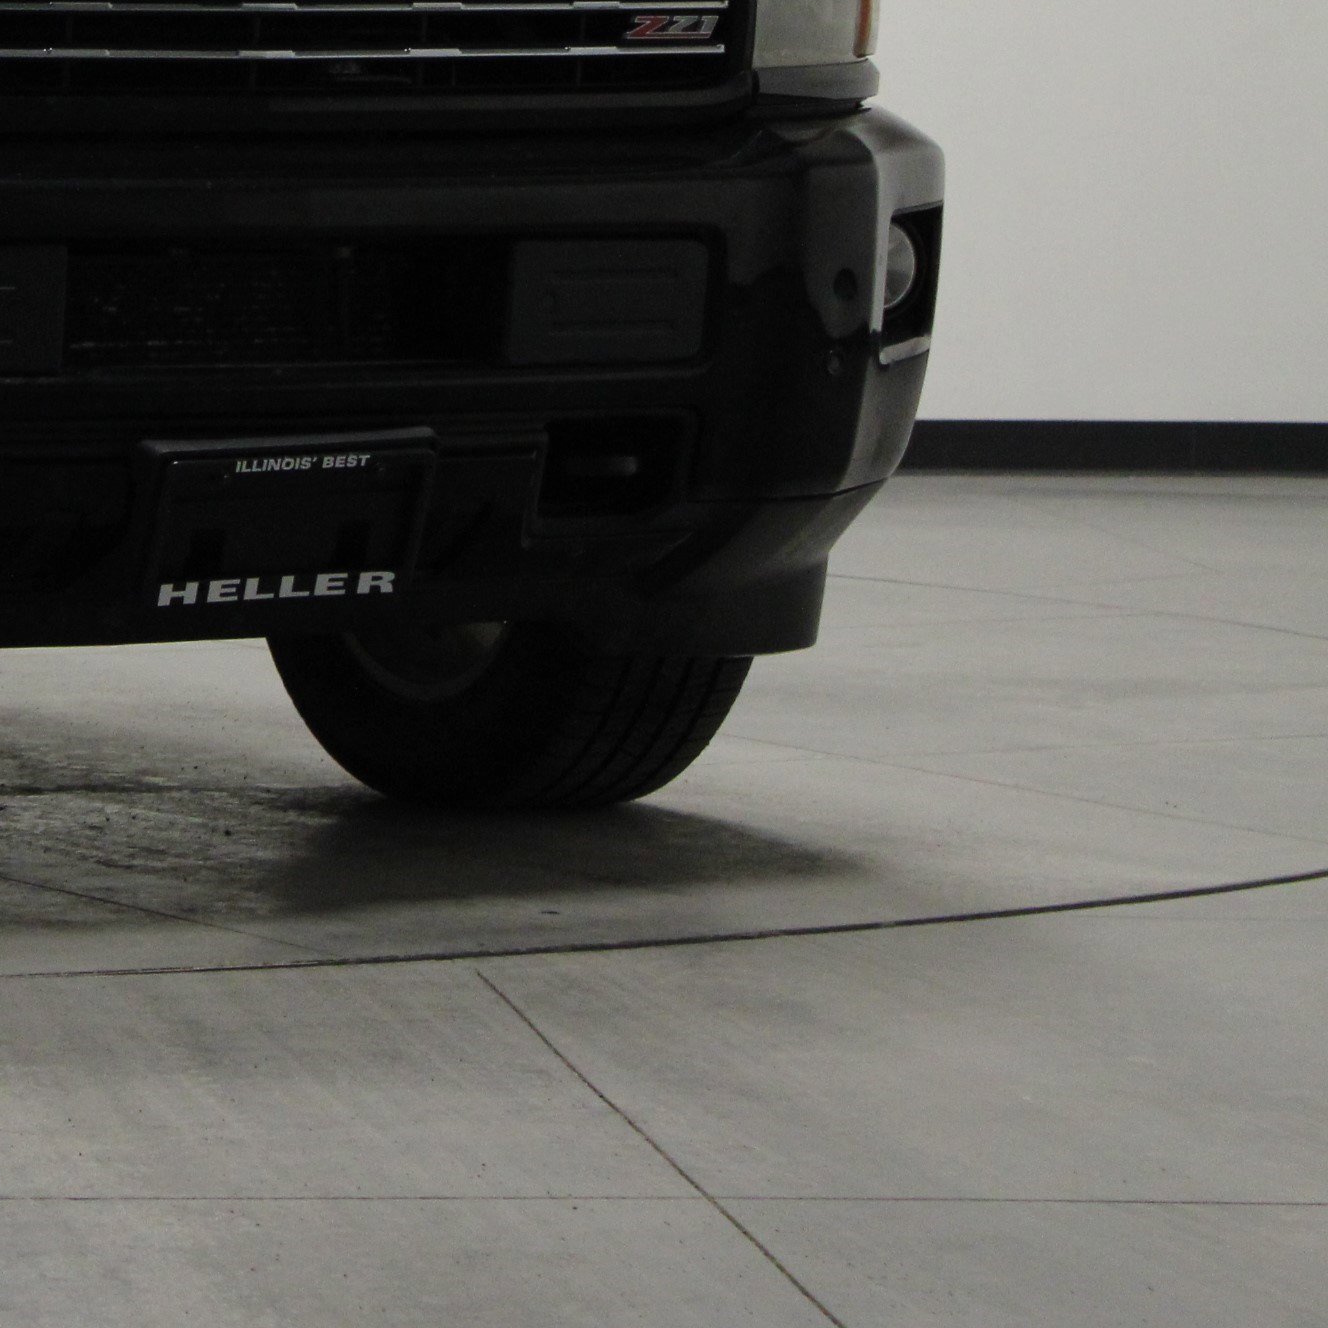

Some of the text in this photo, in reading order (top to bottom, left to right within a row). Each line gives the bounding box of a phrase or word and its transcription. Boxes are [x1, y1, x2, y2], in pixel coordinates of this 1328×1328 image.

[625, 15, 719, 39] Z71
[321, 455, 370, 469] BEST
[157, 571, 396, 607] HELLER
